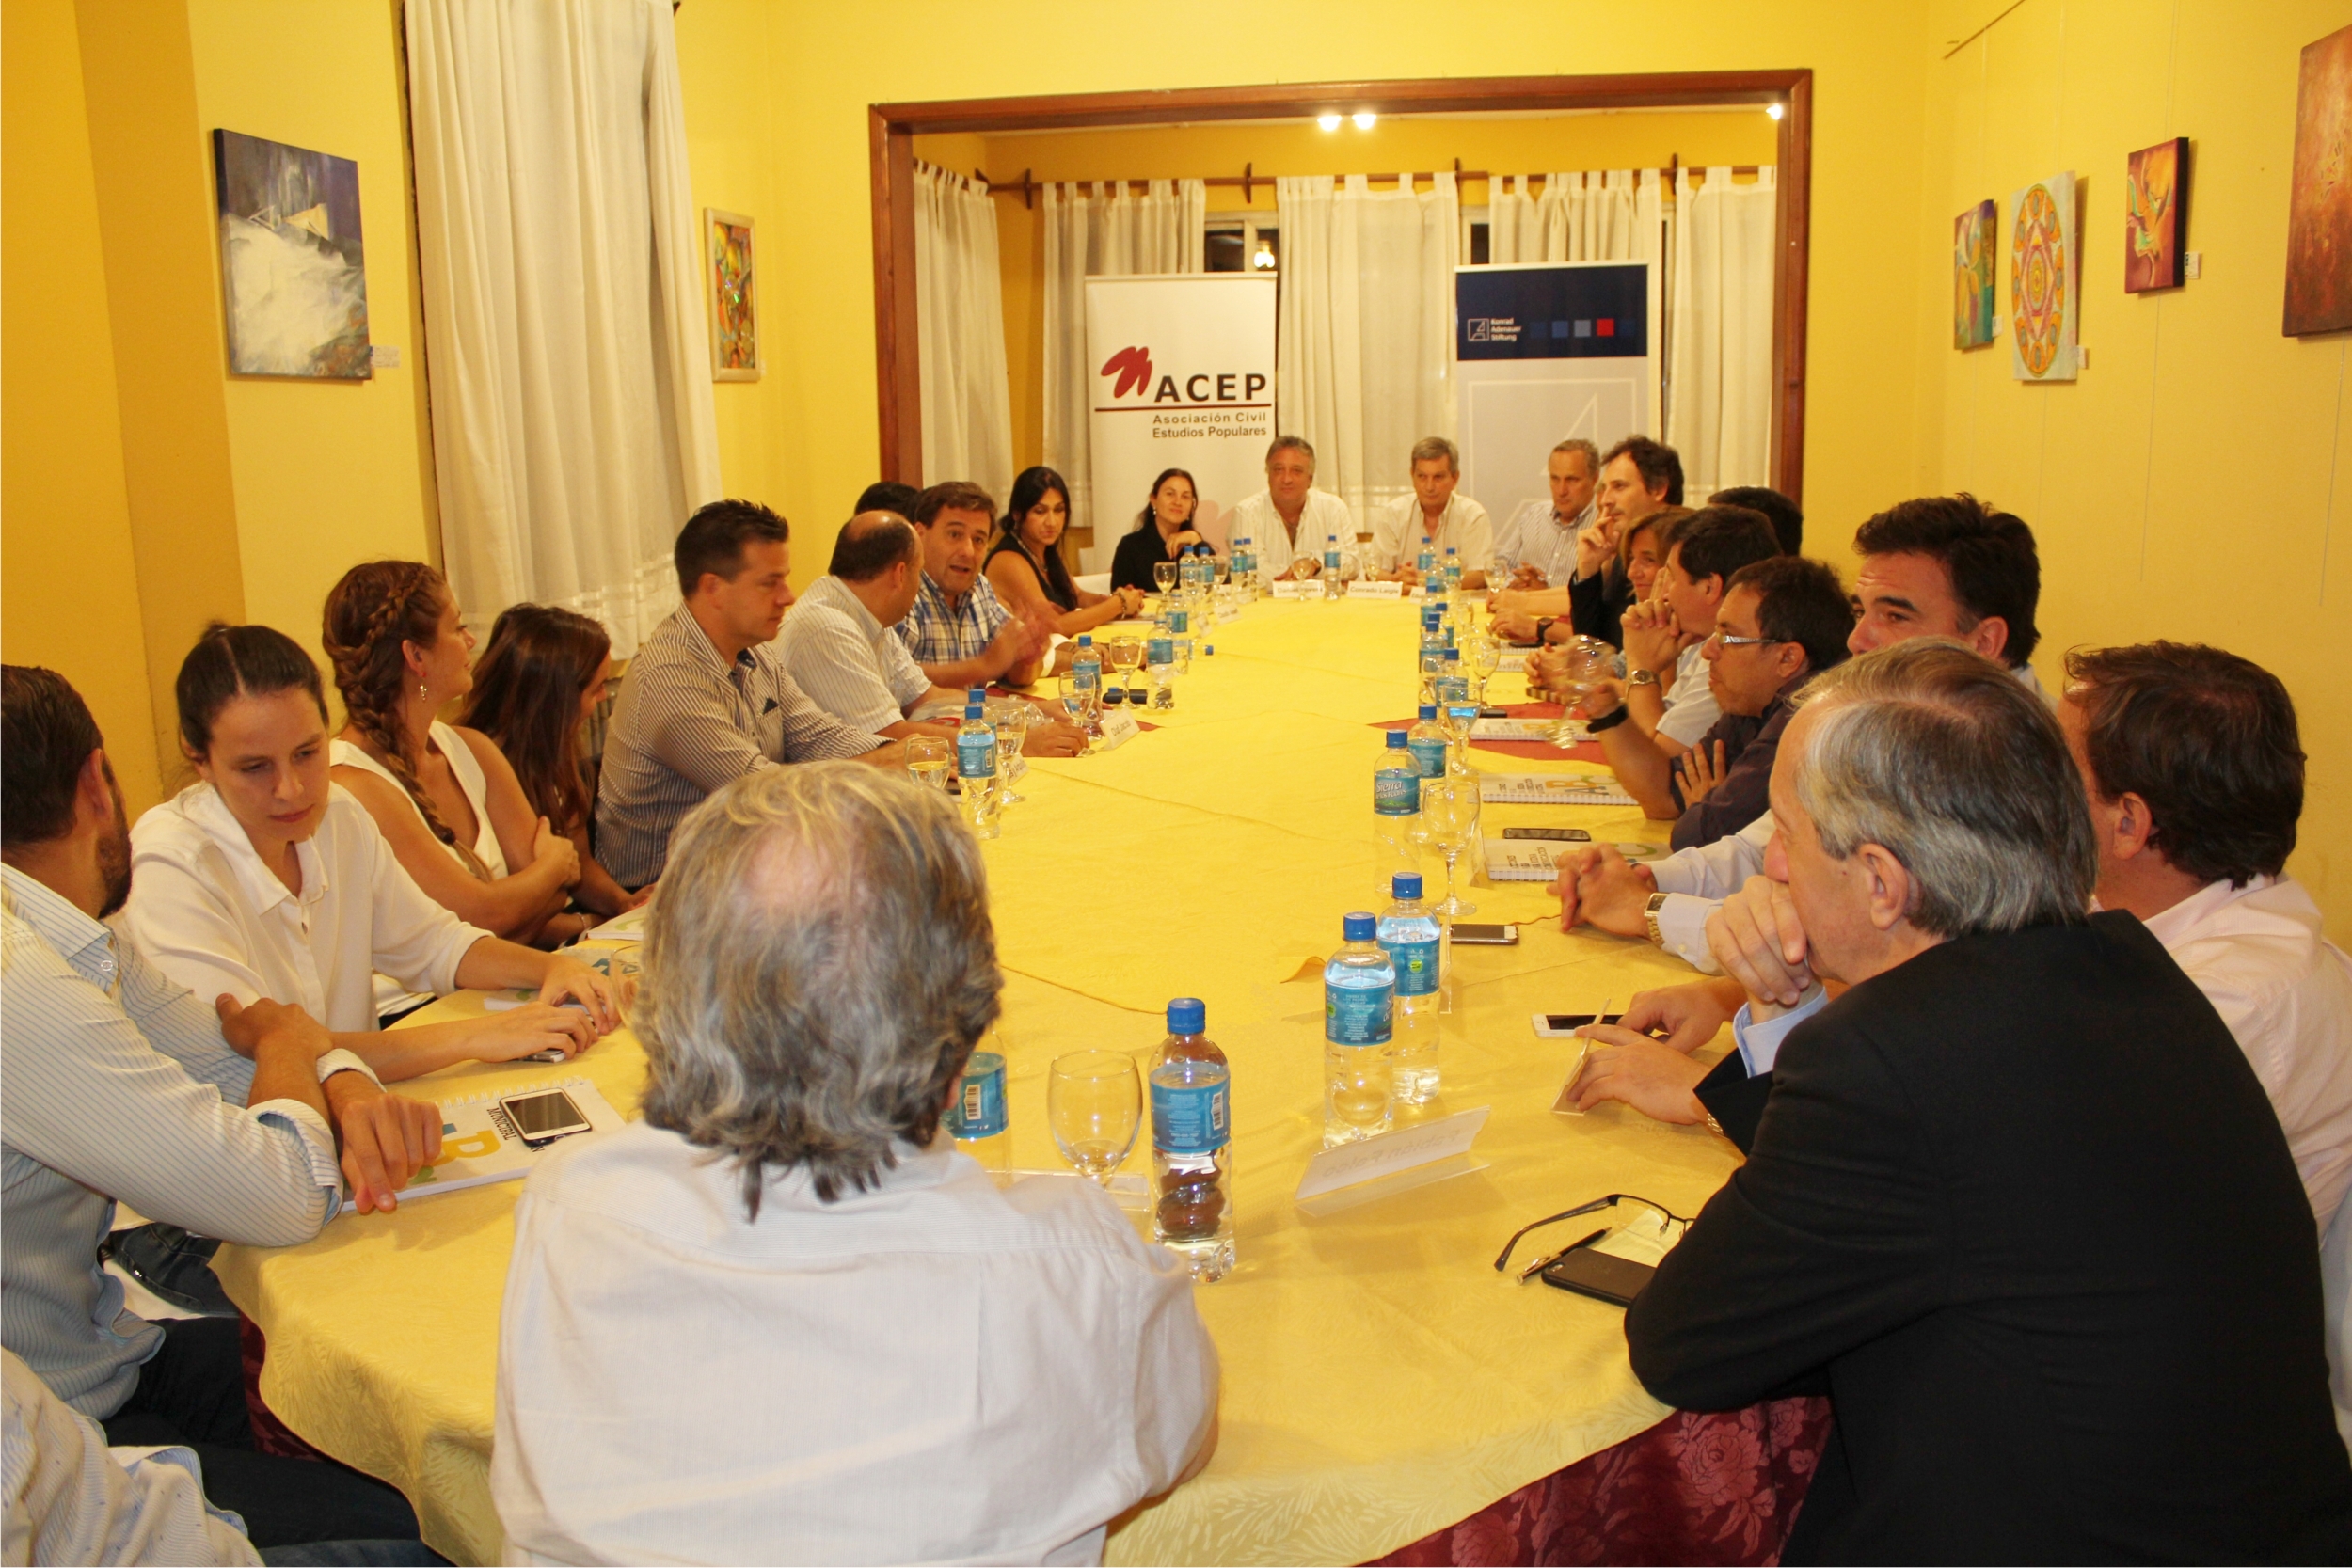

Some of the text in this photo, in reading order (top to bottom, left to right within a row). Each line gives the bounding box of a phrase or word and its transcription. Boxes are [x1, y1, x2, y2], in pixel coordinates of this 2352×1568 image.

[1490, 333, 1518, 341] Stiftung
[1154, 373, 1267, 403] ACEP
[1153, 411, 1266, 424] Asociación Civil
[1152, 426, 1267, 438] Estudios Populares
[1376, 781, 1404, 794] Sierra
[486, 1107, 517, 1141] MUNICIPAL
